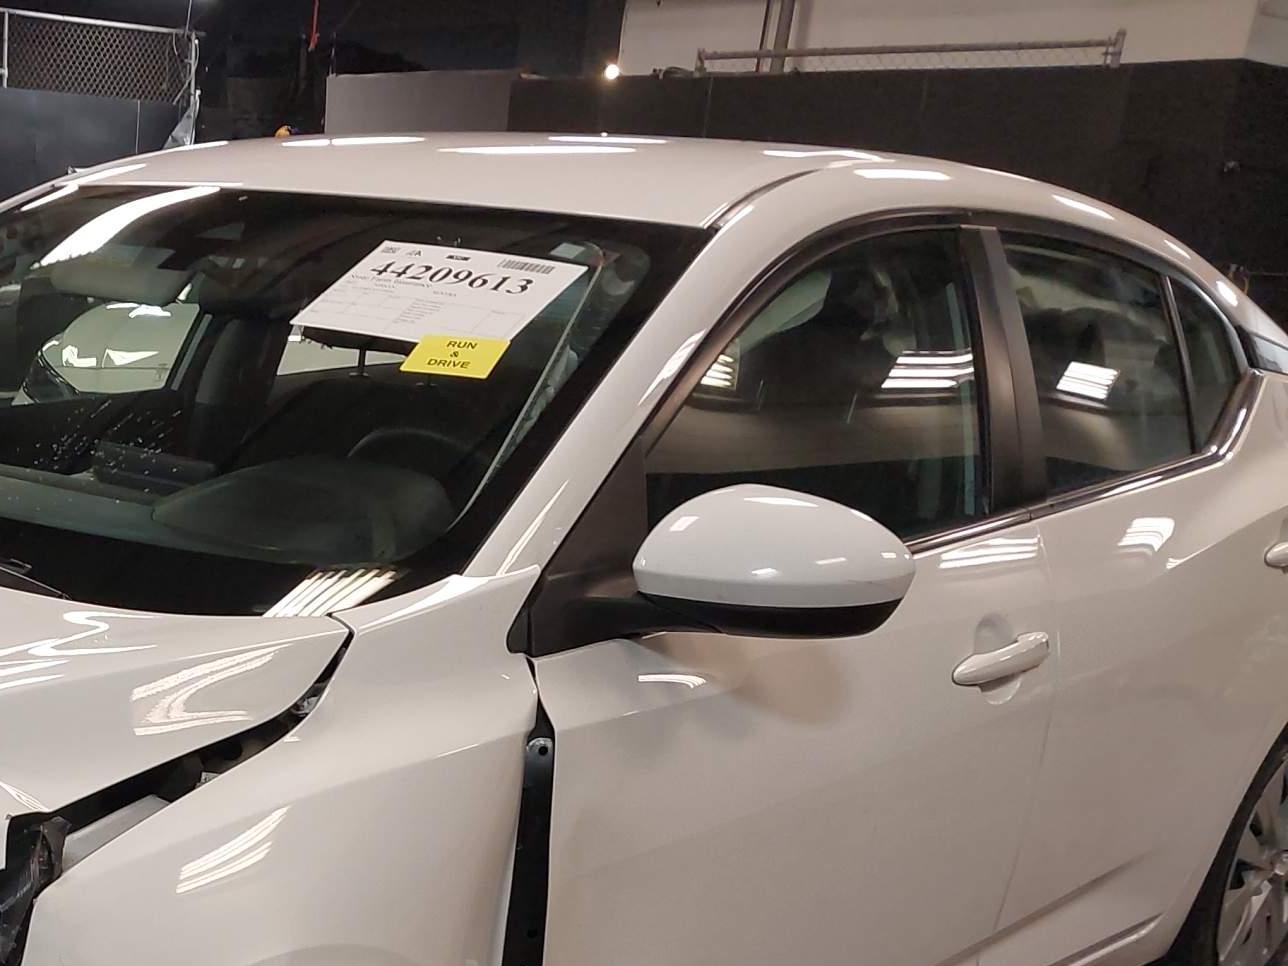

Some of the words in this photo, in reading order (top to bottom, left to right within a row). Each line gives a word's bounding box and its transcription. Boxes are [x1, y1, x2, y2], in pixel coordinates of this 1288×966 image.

[370, 260, 534, 295] 44209613
[446, 340, 478, 350] RUN
[449, 350, 460, 358] &
[426, 358, 471, 369] DRIVE
